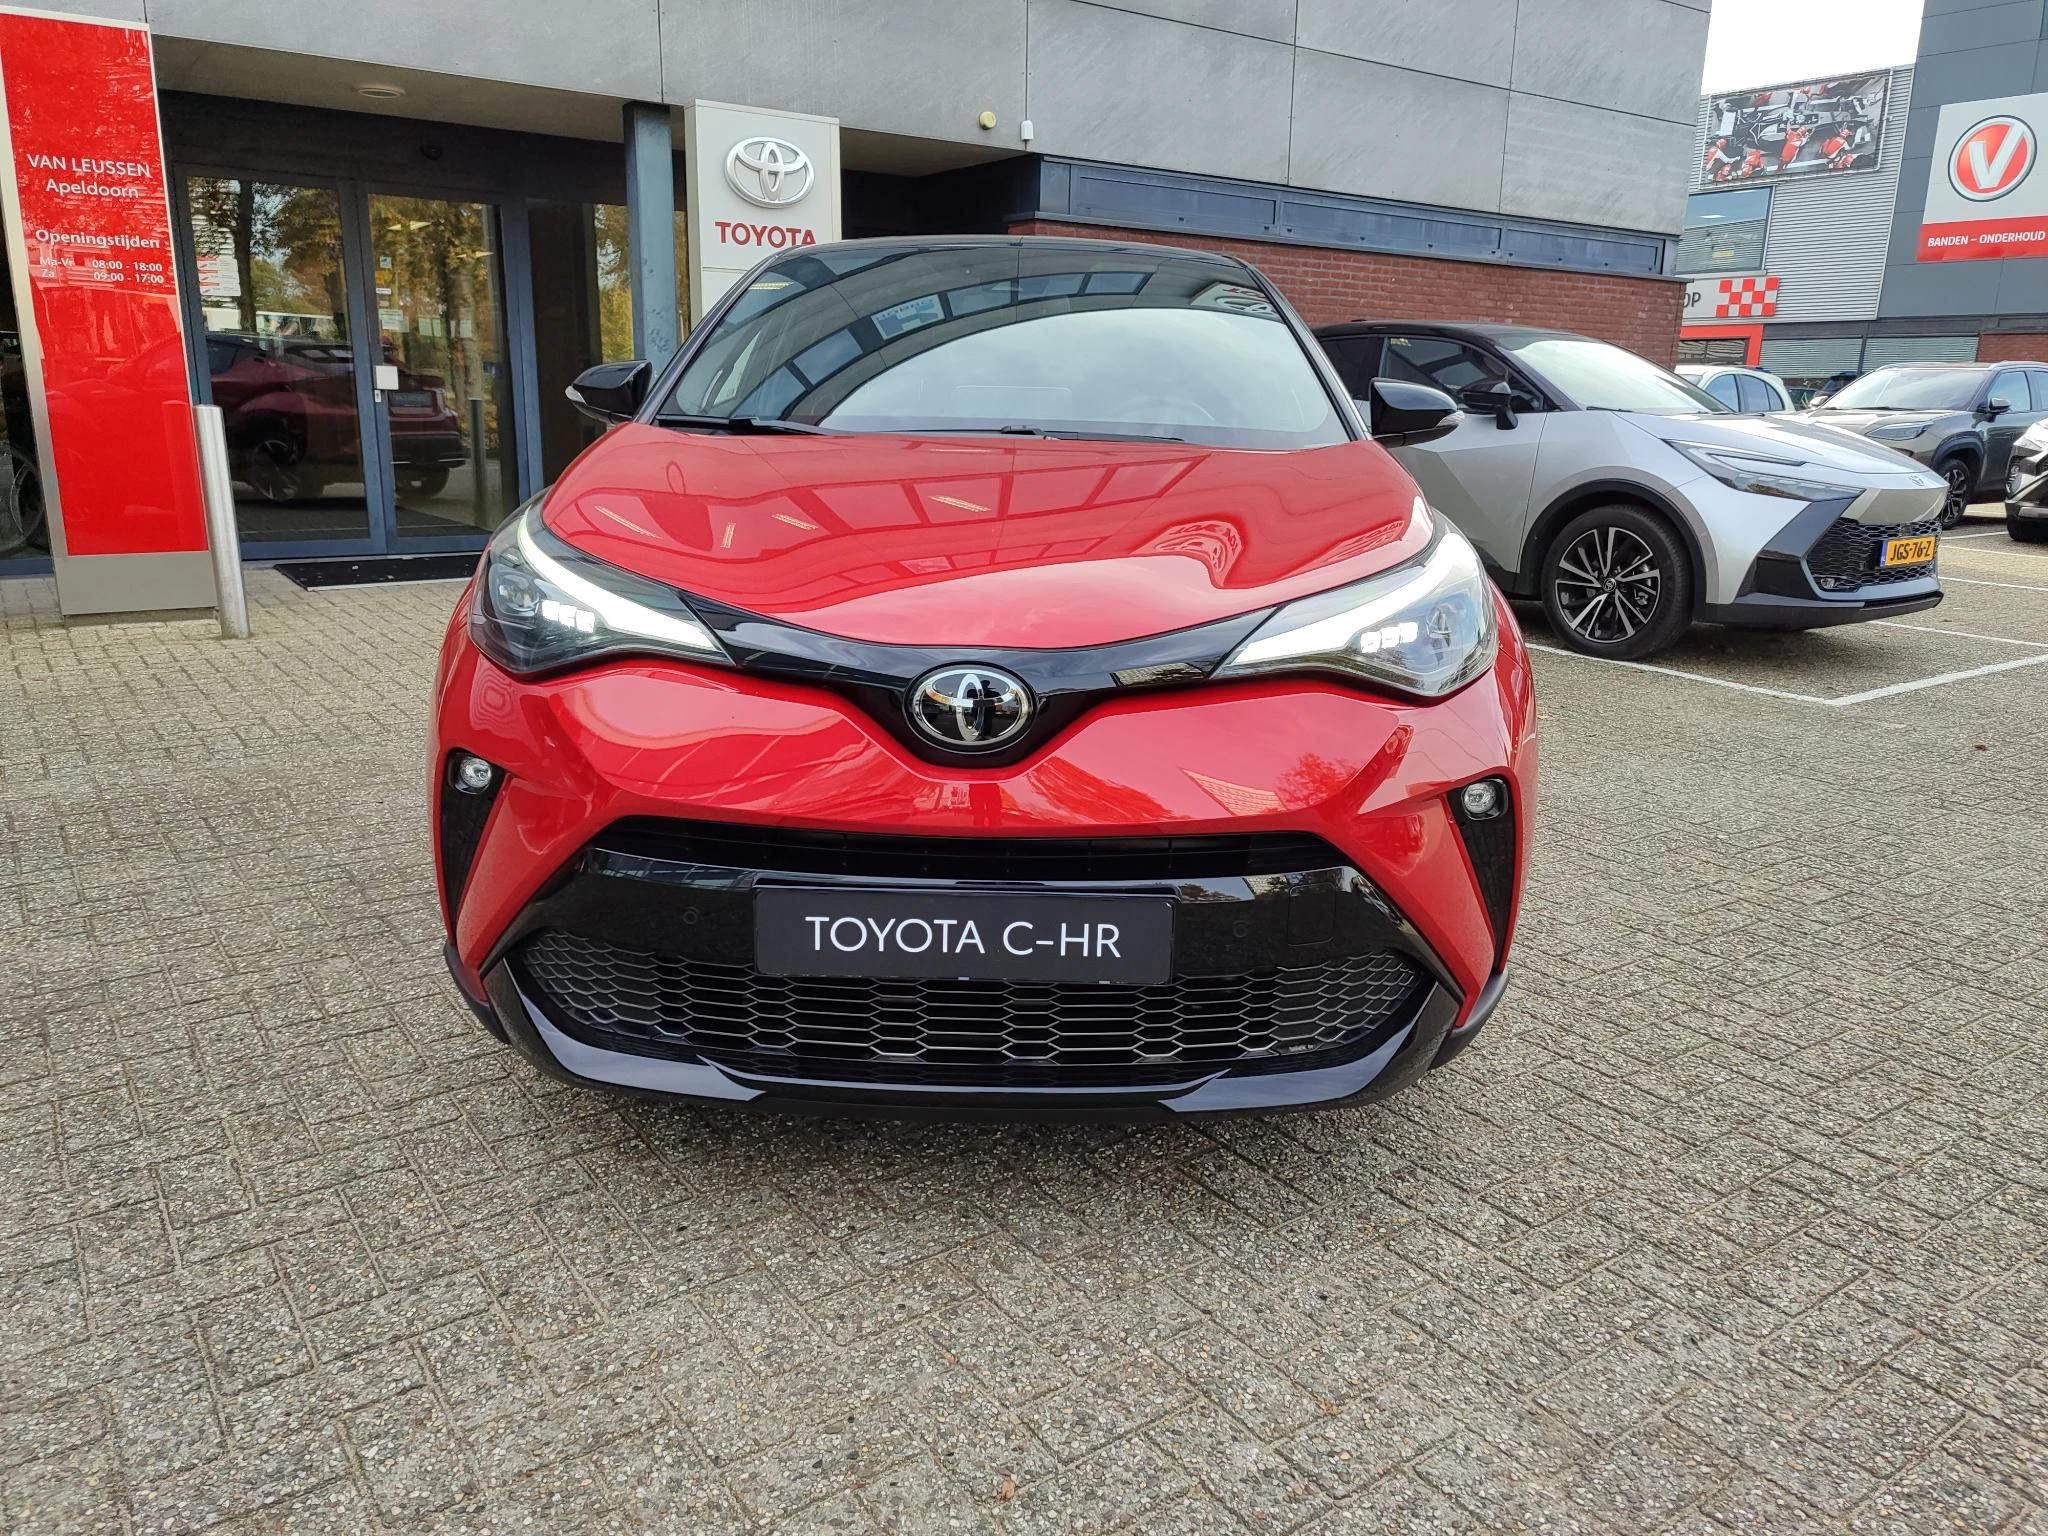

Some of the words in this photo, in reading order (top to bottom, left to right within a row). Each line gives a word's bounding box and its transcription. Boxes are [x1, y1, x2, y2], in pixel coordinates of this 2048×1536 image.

[27, 153, 66, 170] VAN
[72, 158, 151, 177] LEUSSEN
[46, 178, 139, 198] Apeldoorn
[35, 229, 161, 250] Openingstijden
[715, 221, 816, 248] TOYOTA
[1928, 235, 1969, 247] BANDEN
[1979, 231, 2046, 244] ONDERHOUD
[39, 256, 74, 267] Ma-Vr
[92, 259, 123, 270] 08:00
[134, 262, 163, 272] 18:00
[41, 269, 57, 278] Za
[94, 271, 124, 282] 09:00
[135, 274, 165, 284] 17:00
[1890, 541, 1931, 561] JGS-76-Z
[805, 916, 986, 954] TOYOTA
[1002, 921, 1122, 958] C-HR
